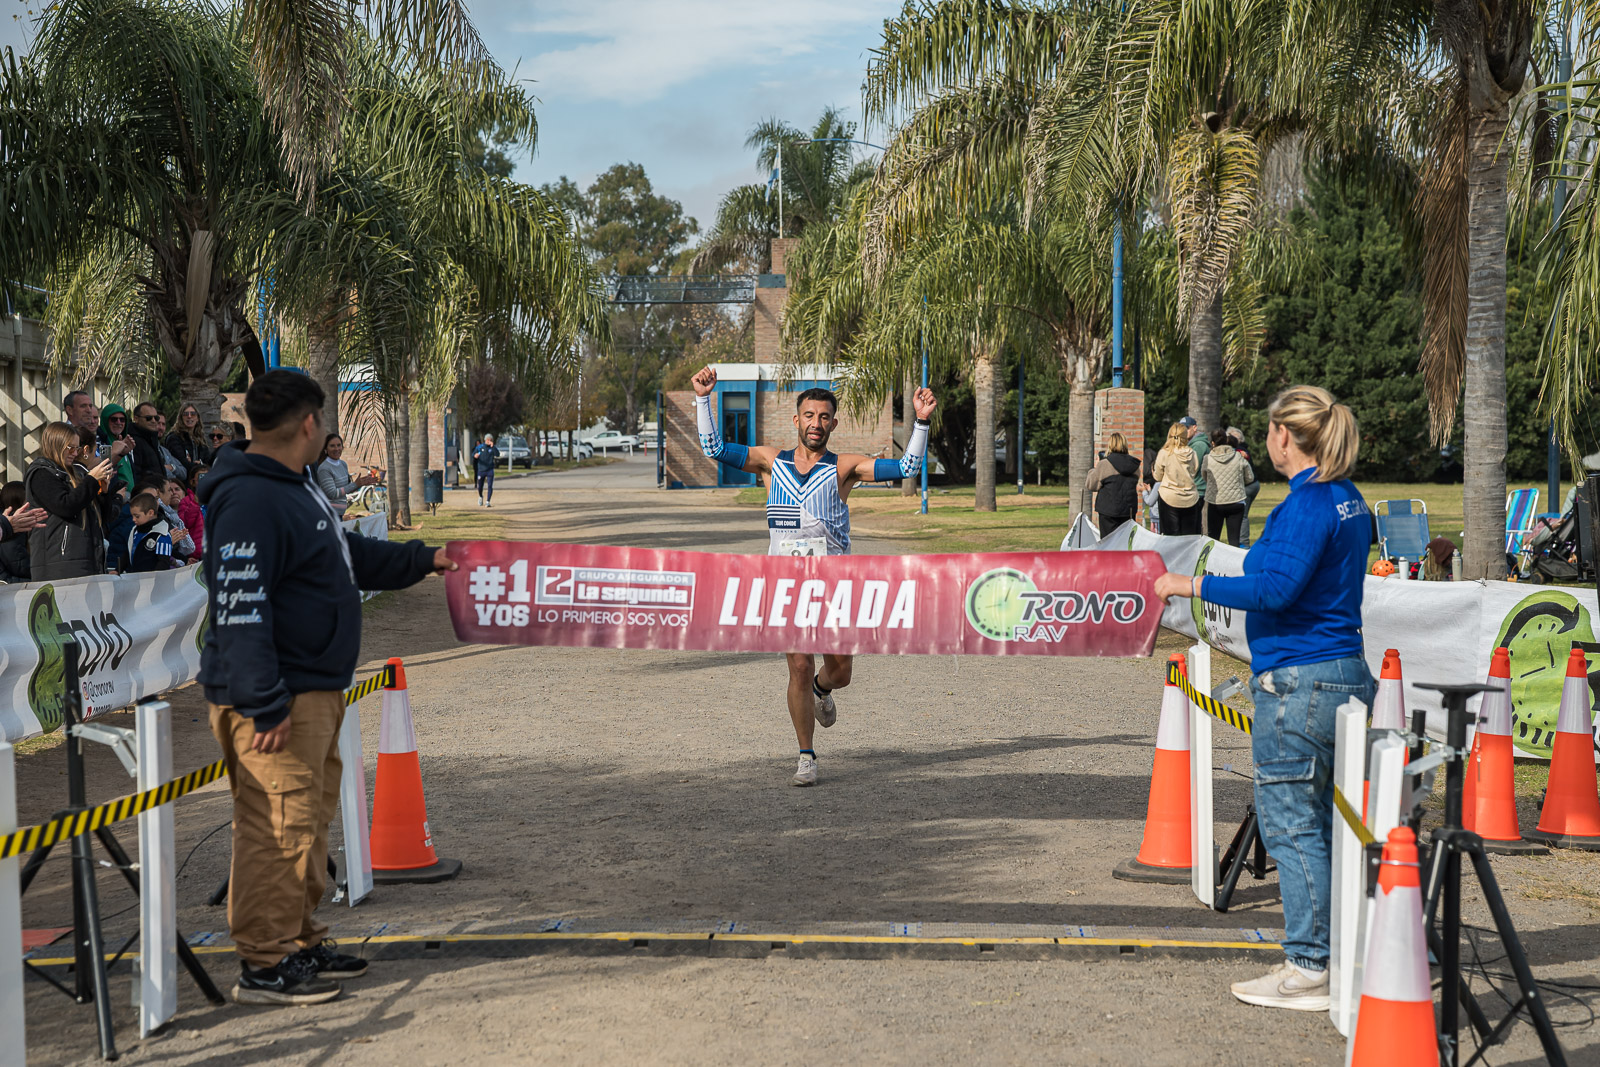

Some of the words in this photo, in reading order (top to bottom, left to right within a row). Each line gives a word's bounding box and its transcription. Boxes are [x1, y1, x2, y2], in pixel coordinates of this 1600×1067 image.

[220, 542, 236, 560] El
[224, 564, 260, 587] pueblo
[469, 559, 531, 603] #1
[579, 571, 615, 581] GRUPO
[617, 572, 689, 584] ASEGURADOR
[229, 586, 267, 609] grande
[577, 583, 599, 600] La
[601, 586, 688, 604] segunda
[718, 577, 917, 629] LLEGADA
[474, 603, 530, 627] VOS
[537, 610, 558, 623] LO
[562, 611, 623, 625] PRIMERO
[627, 612, 656, 626] SOS
[658, 613, 689, 627] VOS
[1013, 625, 1068, 642] RAV
